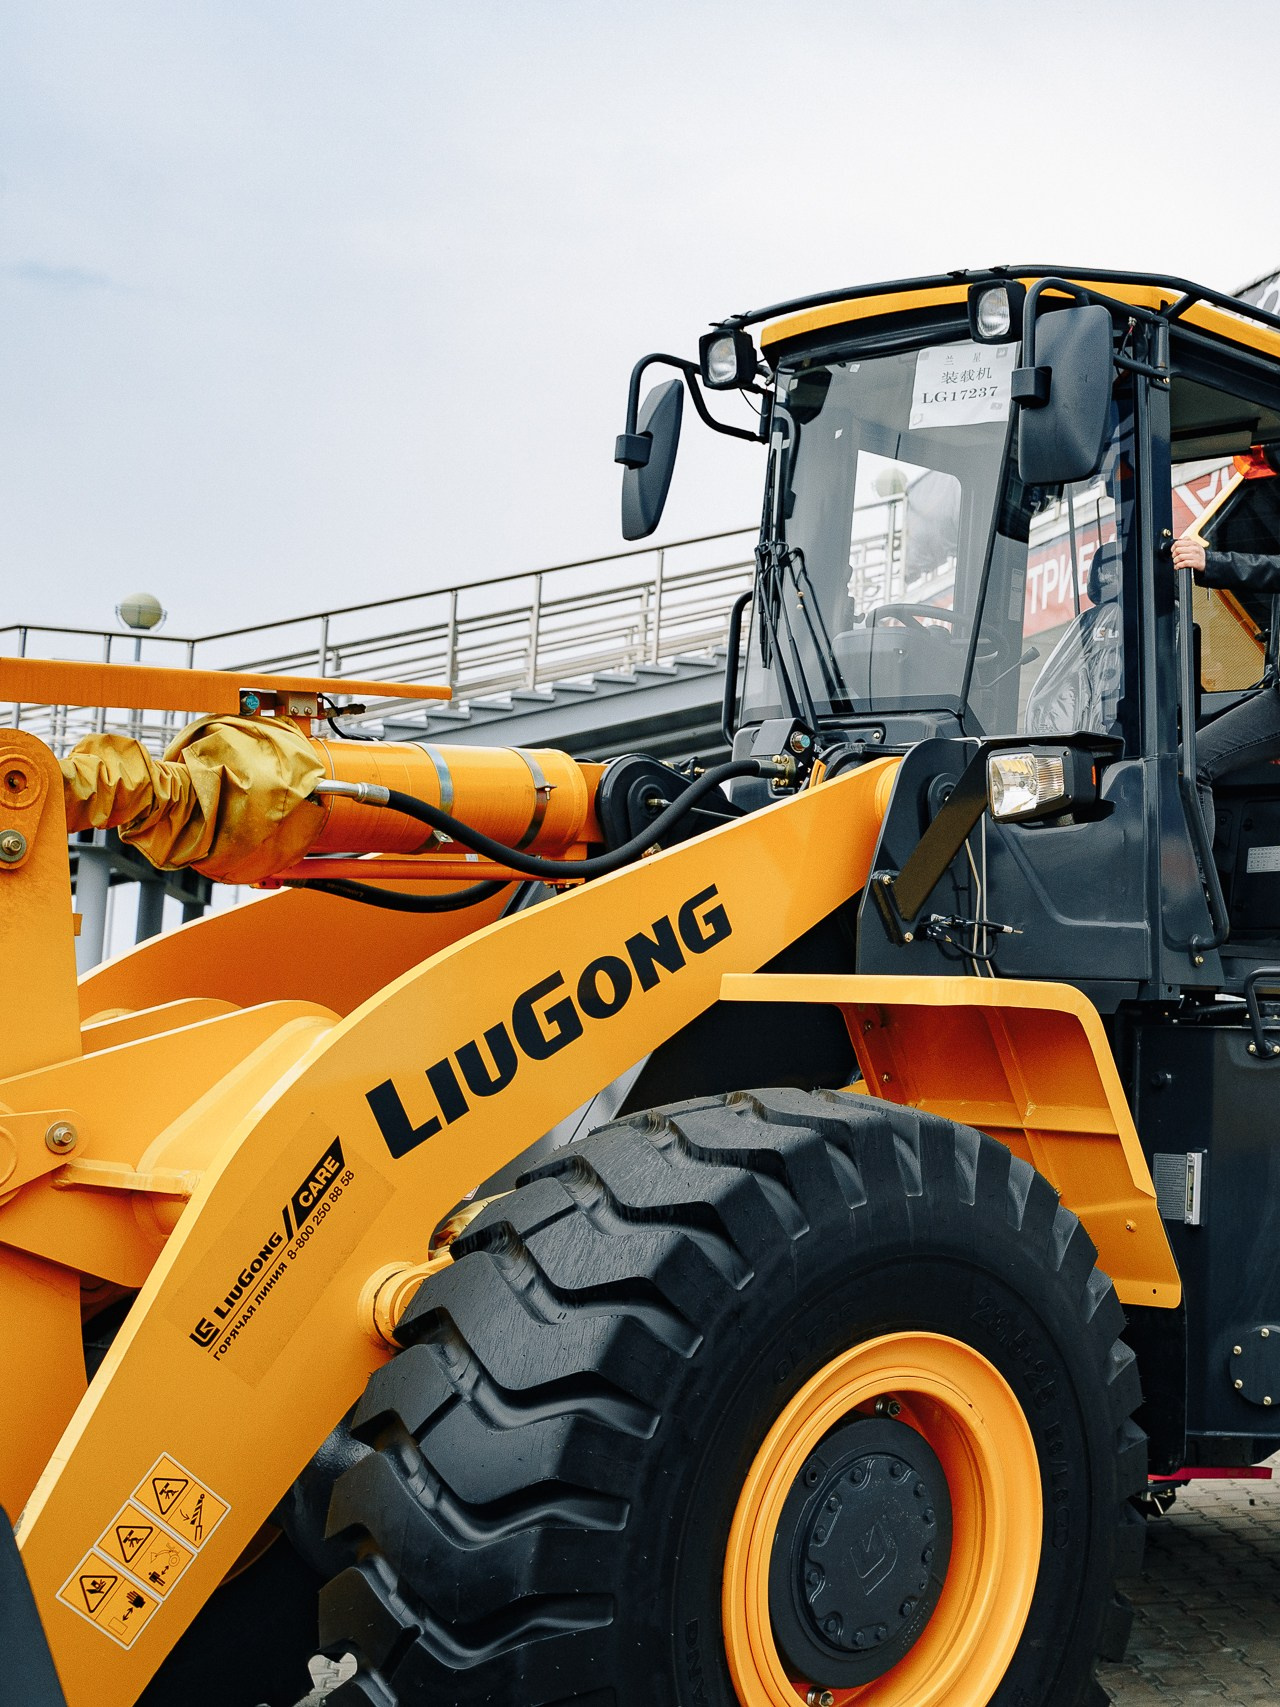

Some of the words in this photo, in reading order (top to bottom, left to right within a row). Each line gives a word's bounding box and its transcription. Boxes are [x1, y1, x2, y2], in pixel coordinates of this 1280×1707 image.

[921, 386, 998, 404] LG17237
[941, 367, 992, 384] 装载机
[365, 883, 732, 1160] LIUGONG
[213, 1231, 283, 1320] LIUGONG
[298, 1155, 340, 1208] CARE
[213, 1305, 257, 1361] ГОРЯЧАЯ
[255, 1262, 288, 1306] ЛИНИЯ
[286, 1225, 315, 1260] 8-800
[312, 1202, 331, 1226] 250
[328, 1185, 343, 1203] 88
[341, 1169, 355, 1187] 58
